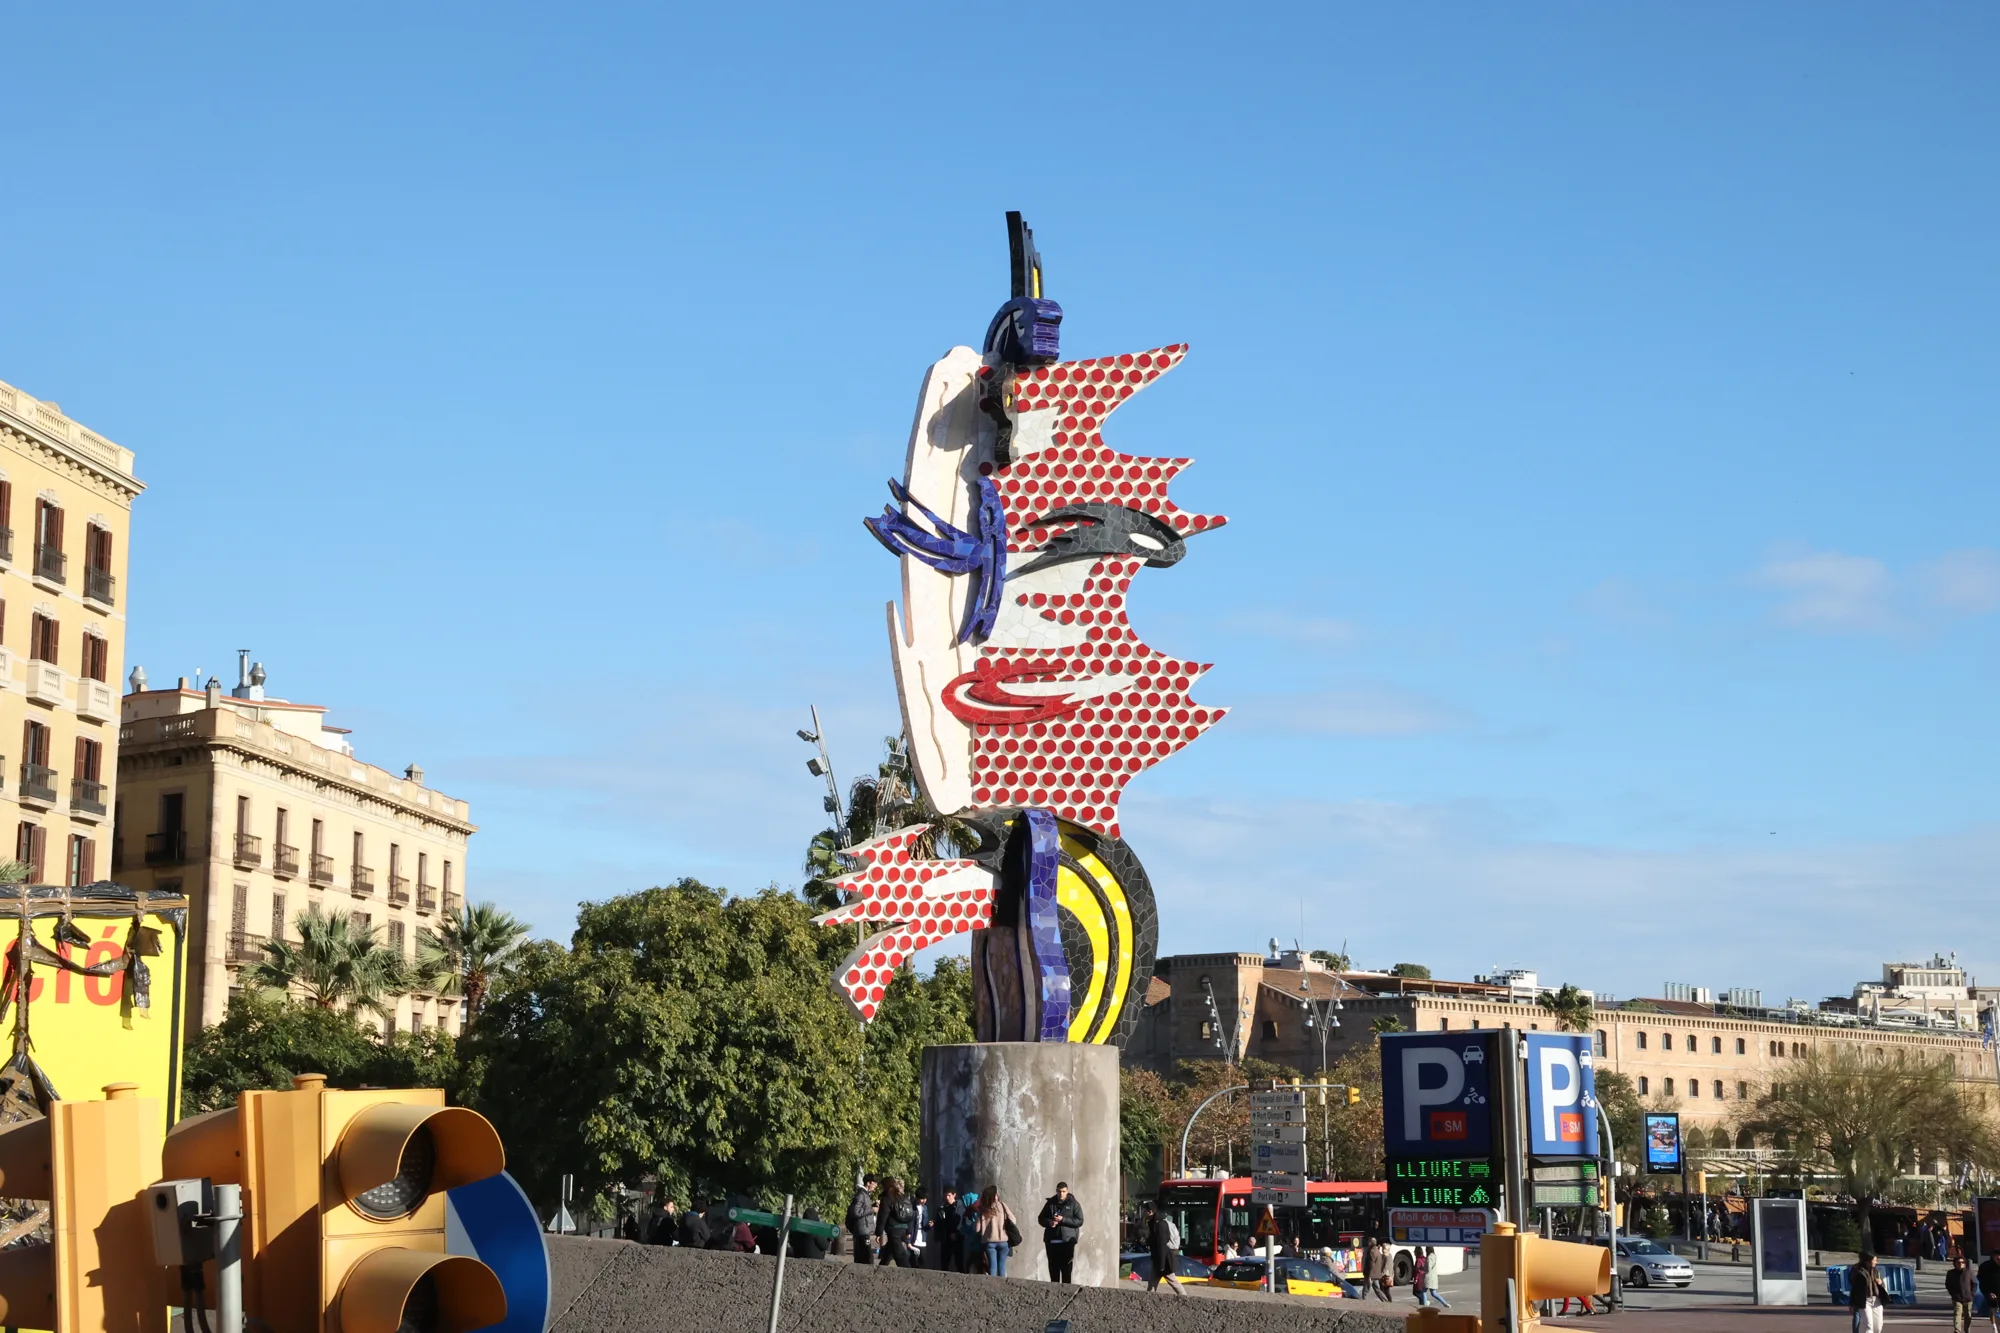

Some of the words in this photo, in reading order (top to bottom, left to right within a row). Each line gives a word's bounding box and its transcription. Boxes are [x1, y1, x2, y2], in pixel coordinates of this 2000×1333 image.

[1402, 1047, 1465, 1141] P
[1540, 1047, 1581, 1141] P
[1397, 1162, 1462, 1177] LLIURE
[1397, 1212, 1418, 1222] Moll
[1422, 1212, 1435, 1222] de
[1439, 1212, 1448, 1223] la
